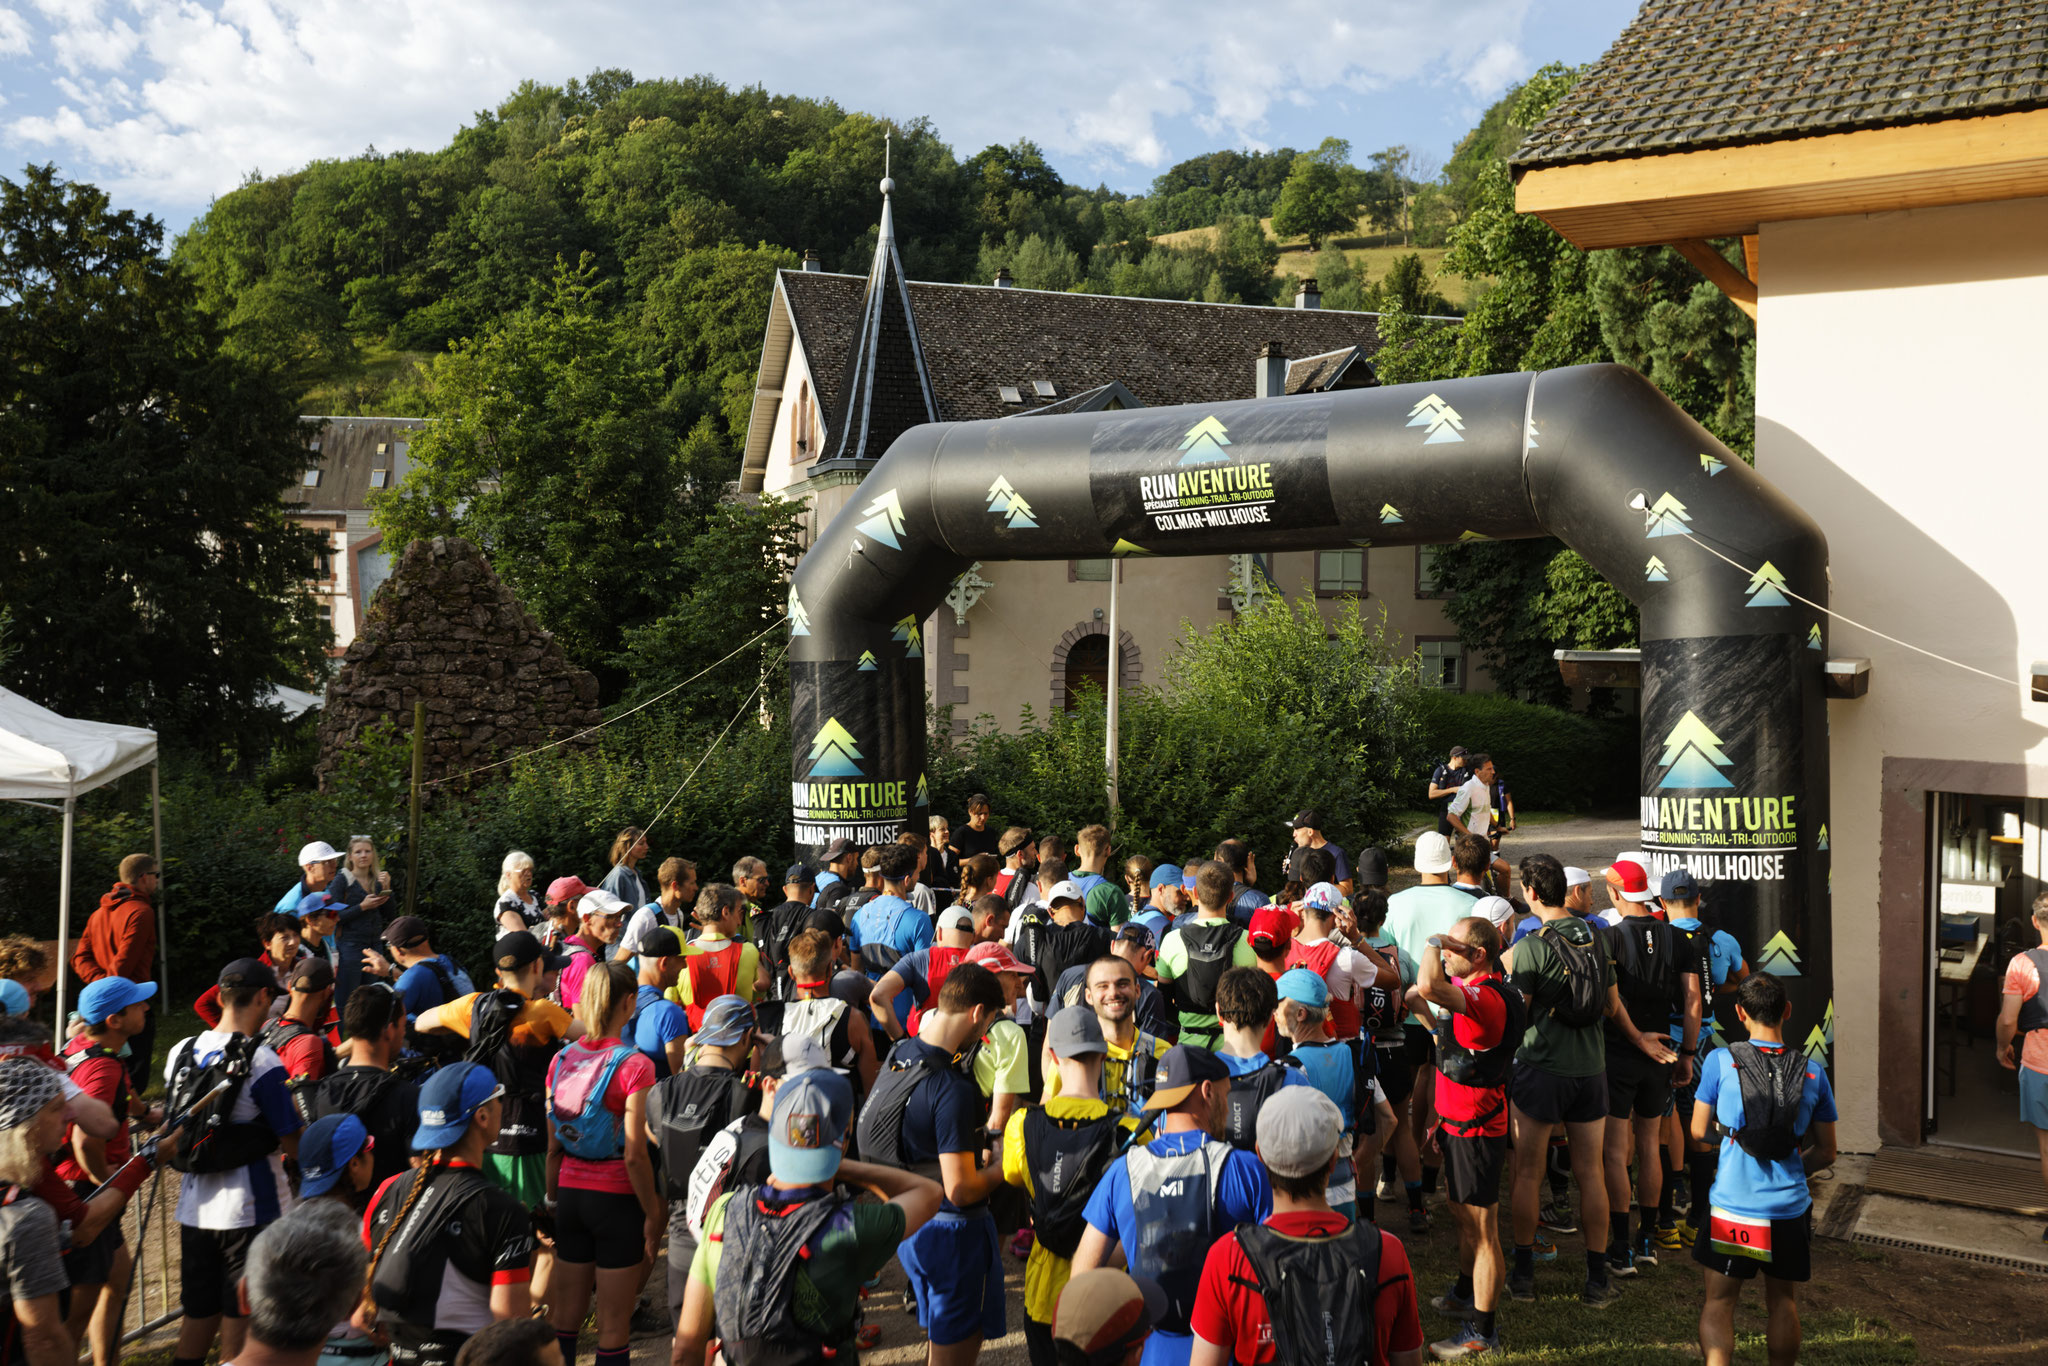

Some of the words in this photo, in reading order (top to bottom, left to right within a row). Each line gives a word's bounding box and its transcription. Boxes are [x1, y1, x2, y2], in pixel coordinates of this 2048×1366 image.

[1140, 463, 1272, 501] RUNAVENTURE
[1144, 499, 1180, 511] SPÉCIALISTE
[1179, 489, 1274, 507] RUNNING-TRAIL-TRI-OUTDOOR
[1155, 506, 1270, 531] COLMAR-MULHOUSE
[808, 807, 907, 820] RUNNING-TRAIL-TRI-OUTDOOR
[1641, 795, 1797, 830] UNAVENTURE
[1659, 831, 1797, 845] RUNNING-TRAIL-TRI-OUTDOOR
[1233, 1101, 1242, 1140] EVADICT
[1052, 1150, 1064, 1194] EVADICT
[1729, 1228, 1750, 1244] 10
